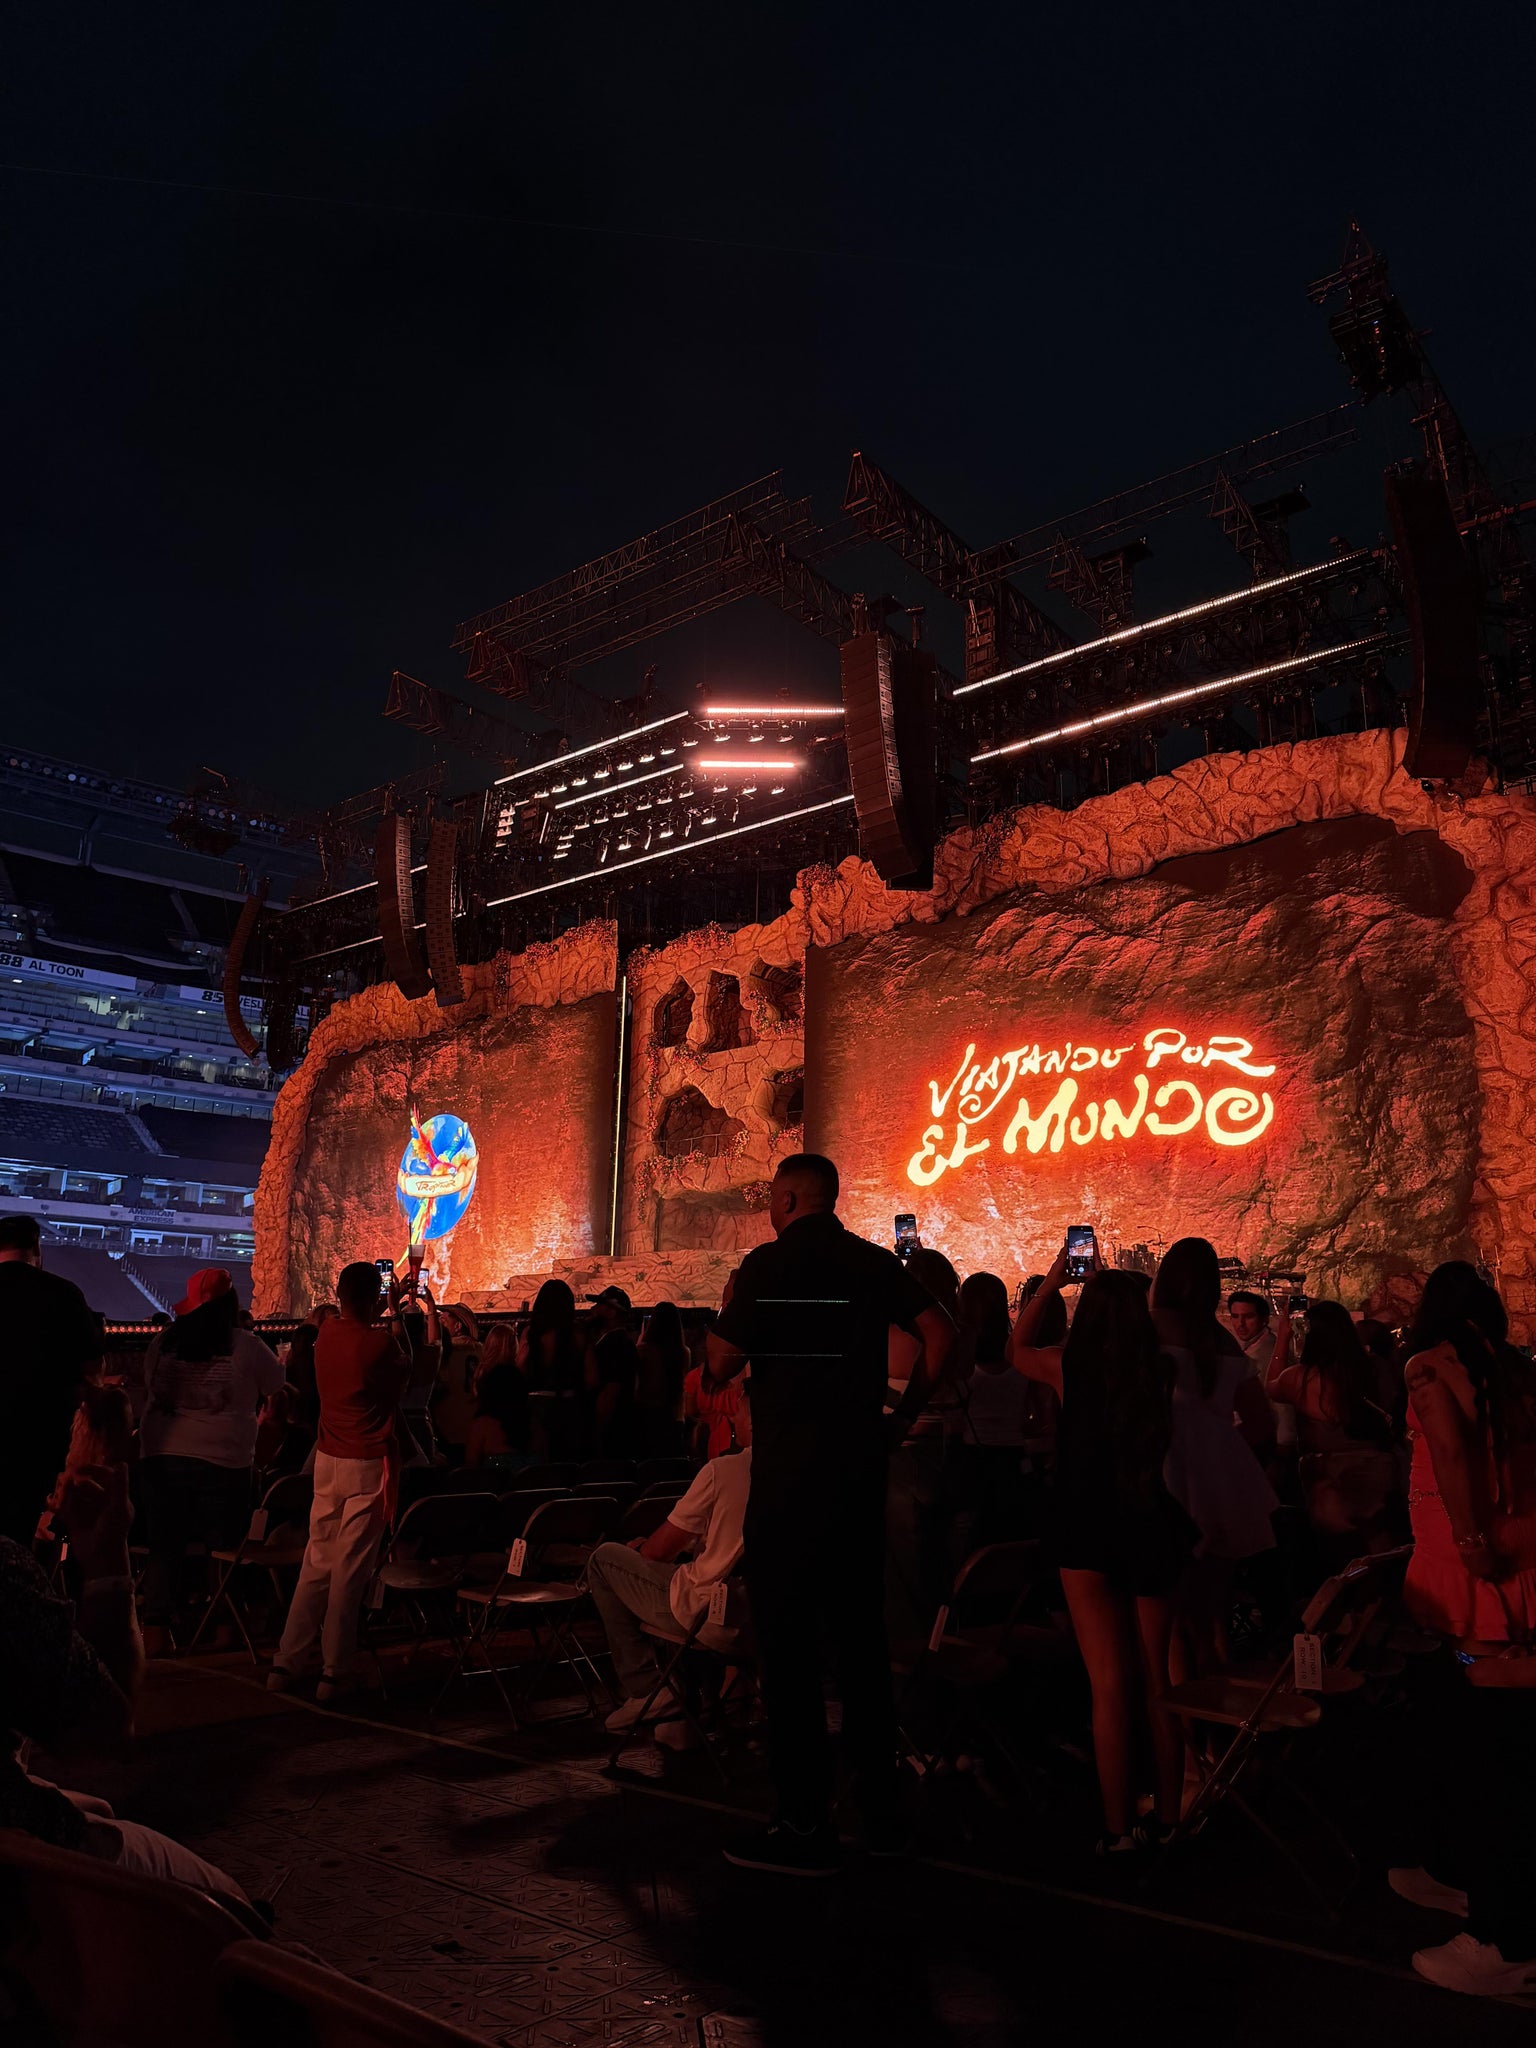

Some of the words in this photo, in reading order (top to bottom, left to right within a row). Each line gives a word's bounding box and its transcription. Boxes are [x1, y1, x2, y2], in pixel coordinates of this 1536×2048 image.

[0, 954, 23, 968] 88
[28, 960, 46, 971] AL
[49, 963, 84, 978] TOON
[202, 990, 224, 1003] 85
[929, 1042, 1136, 1124] VIAJANDO
[1143, 1028, 1276, 1077] POR
[906, 1122, 990, 1187] EL
[1002, 1074, 1274, 1154] MUNDO
[128, 1208, 174, 1217] AMERICAN
[134, 1215, 174, 1224] EXPRESS
